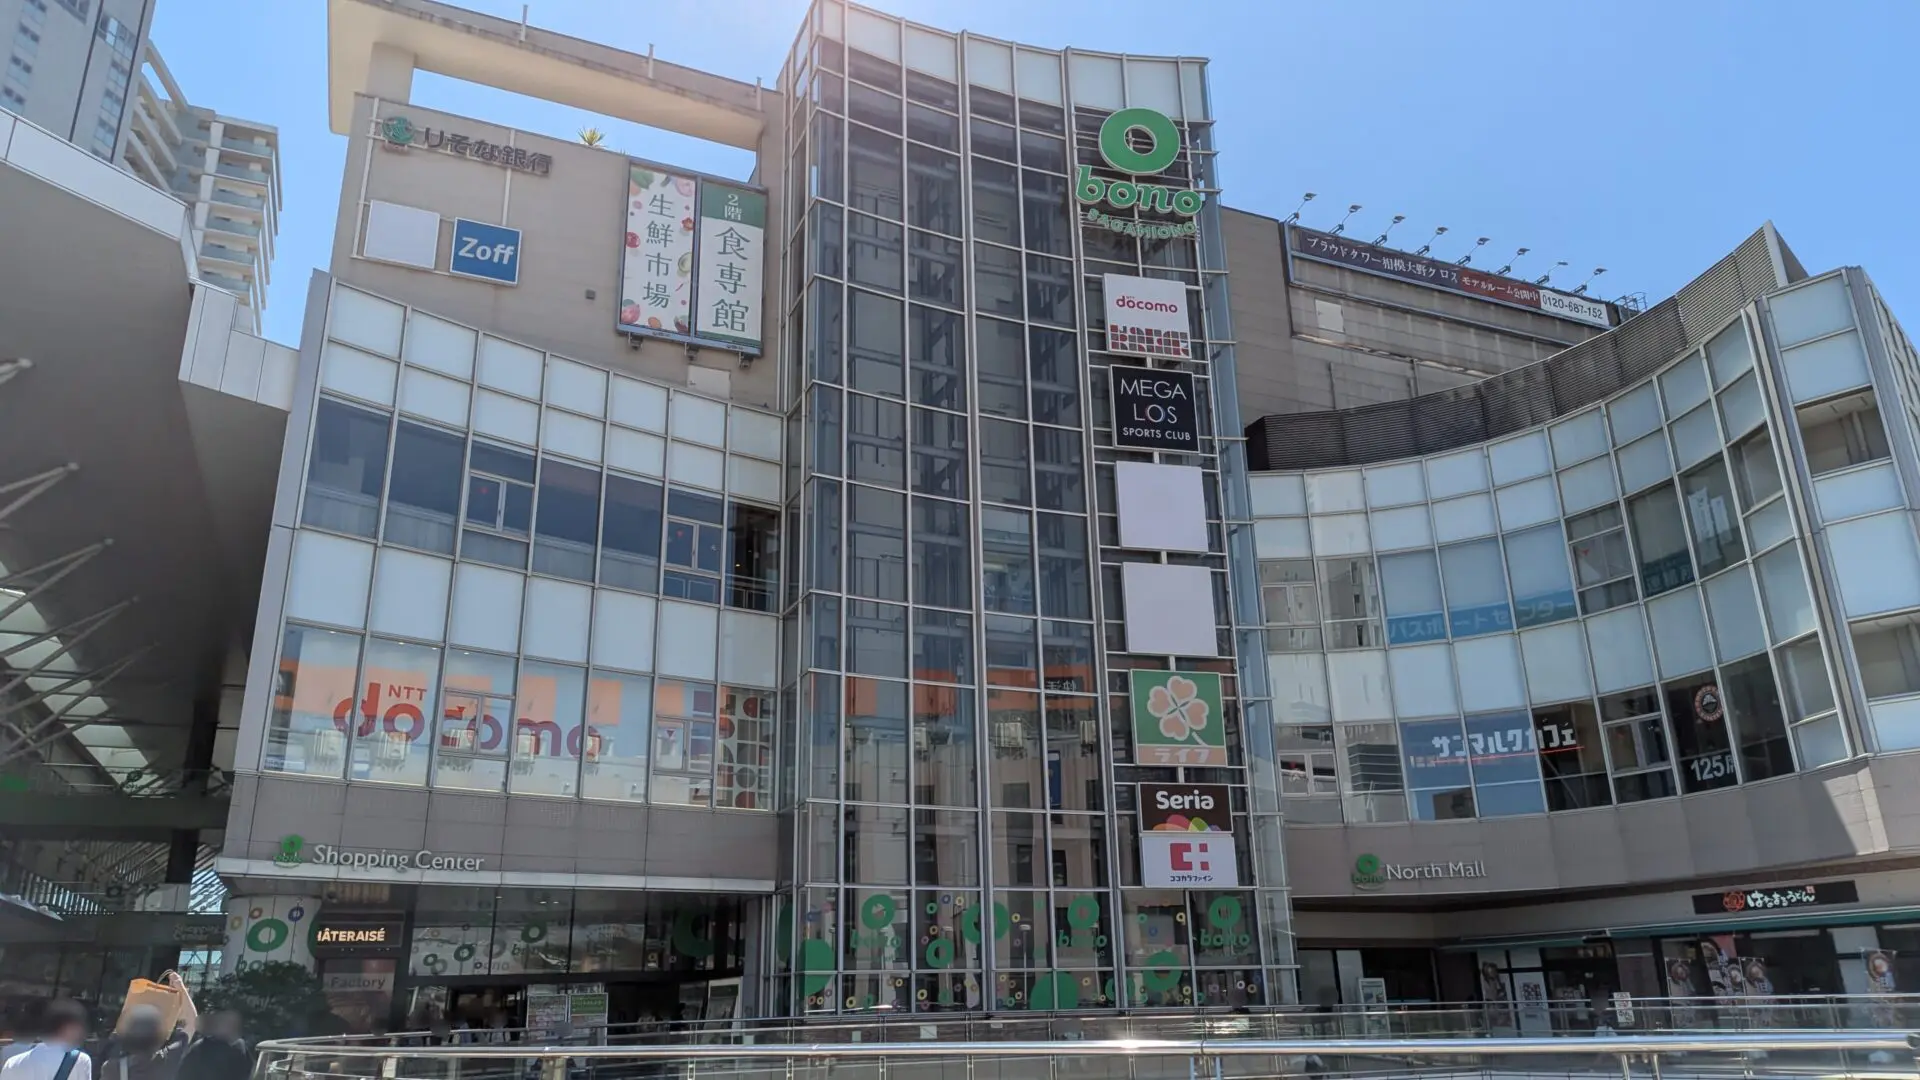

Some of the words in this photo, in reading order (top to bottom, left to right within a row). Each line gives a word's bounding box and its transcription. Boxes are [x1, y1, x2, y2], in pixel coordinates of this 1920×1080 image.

[424, 127, 553, 174] りそな銀行
[1075, 164, 1202, 217] bono
[724, 193, 742, 221] 2階
[458, 236, 514, 265] Zoff
[642, 193, 675, 309] 生鮮市場
[1307, 237, 1458, 284] プラウドタワー相模大野クロス
[712, 226, 750, 332] 食専館
[1116, 295, 1178, 314] docomo
[1542, 294, 1603, 320] 0120-687-152
[1120, 377, 1187, 400] MEGA
[1133, 403, 1178, 424] LOS
[1122, 427, 1162, 439] SPORTS
[1165, 431, 1191, 441] CLUB
[1390, 600, 1575, 639] パスポートセンター
[388, 684, 428, 701] NTT
[333, 681, 602, 759] docomo
[1154, 748, 1211, 764] ライフ
[1155, 789, 1215, 811] Seria
[313, 844, 409, 874] Shopping
[415, 850, 485, 871] Center
[1385, 863, 1443, 881] North
[1449, 860, 1487, 878] Mall
[1170, 874, 1214, 883] ココカラファイン
[1746, 889, 1816, 908] はなまるうどん
[1057, 929, 1108, 949] bo
[330, 975, 386, 990] Factory
